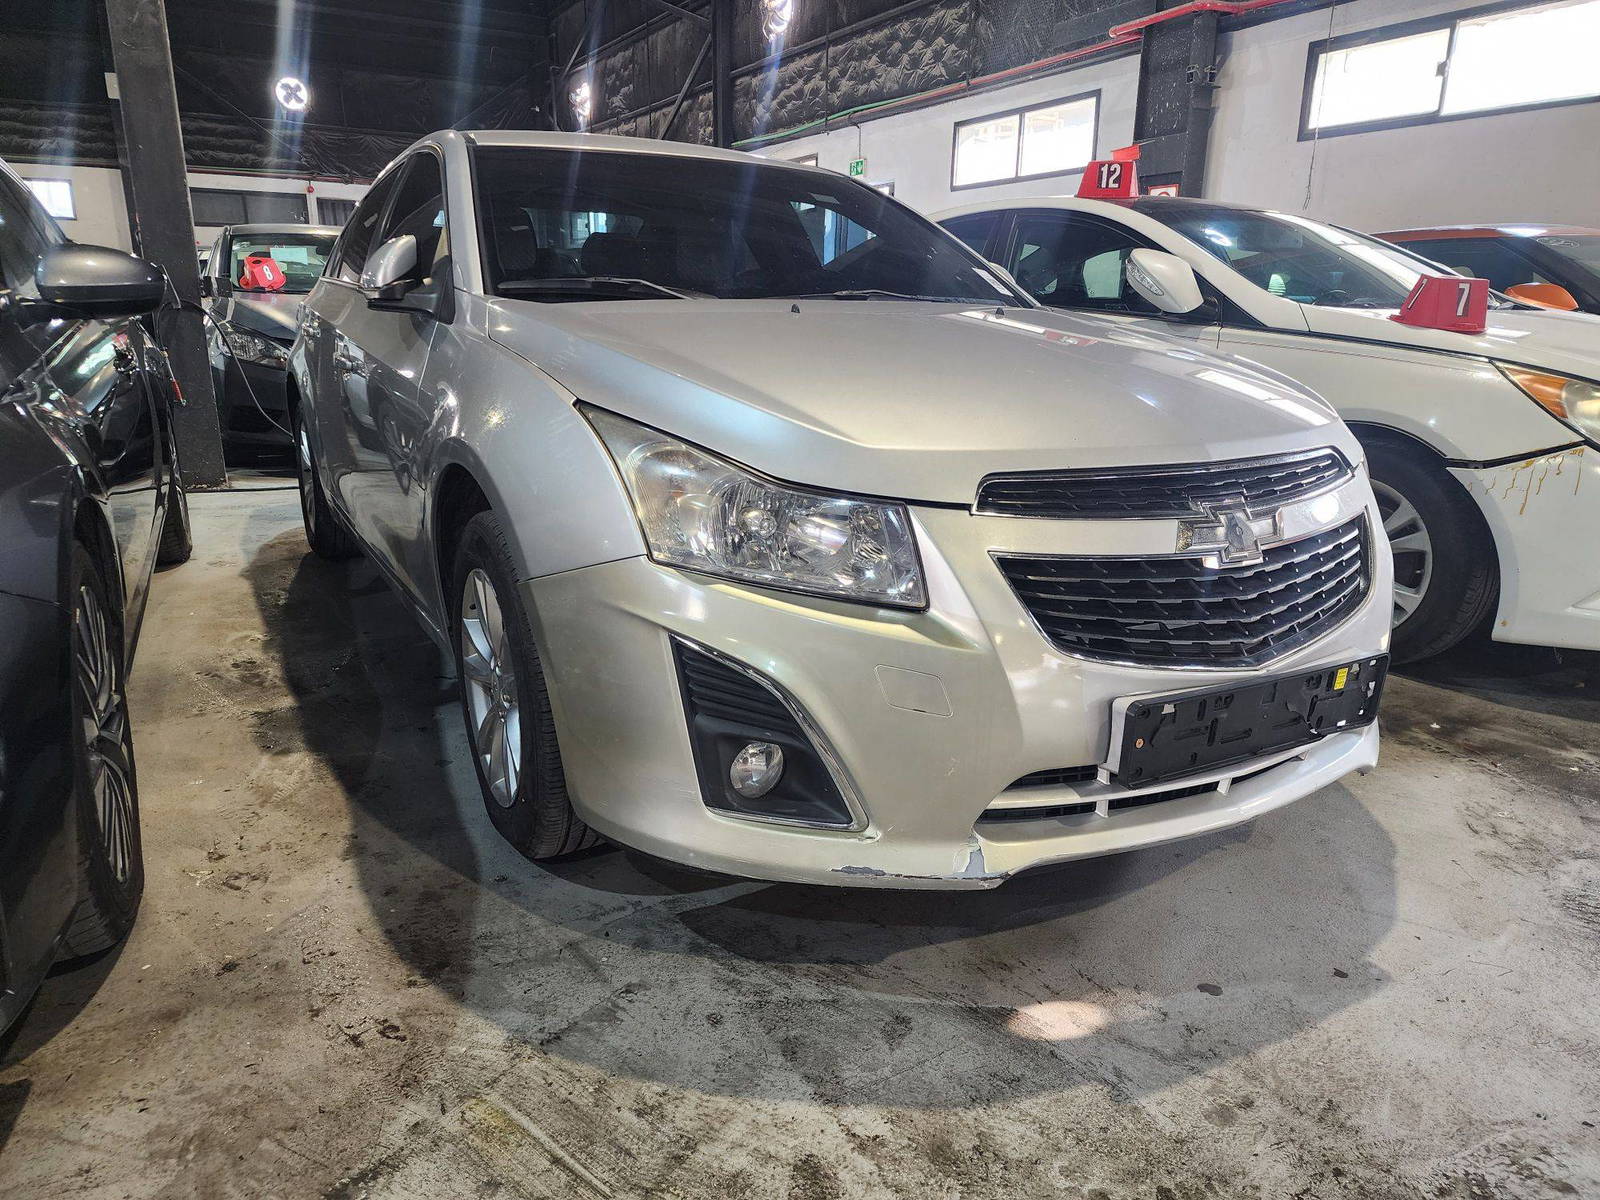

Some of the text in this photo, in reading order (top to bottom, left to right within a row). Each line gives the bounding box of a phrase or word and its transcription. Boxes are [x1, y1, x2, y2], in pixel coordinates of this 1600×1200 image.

[1101, 163, 1121, 188] 12
[262, 265, 274, 281] 8
[1456, 283, 1470, 316] 7
